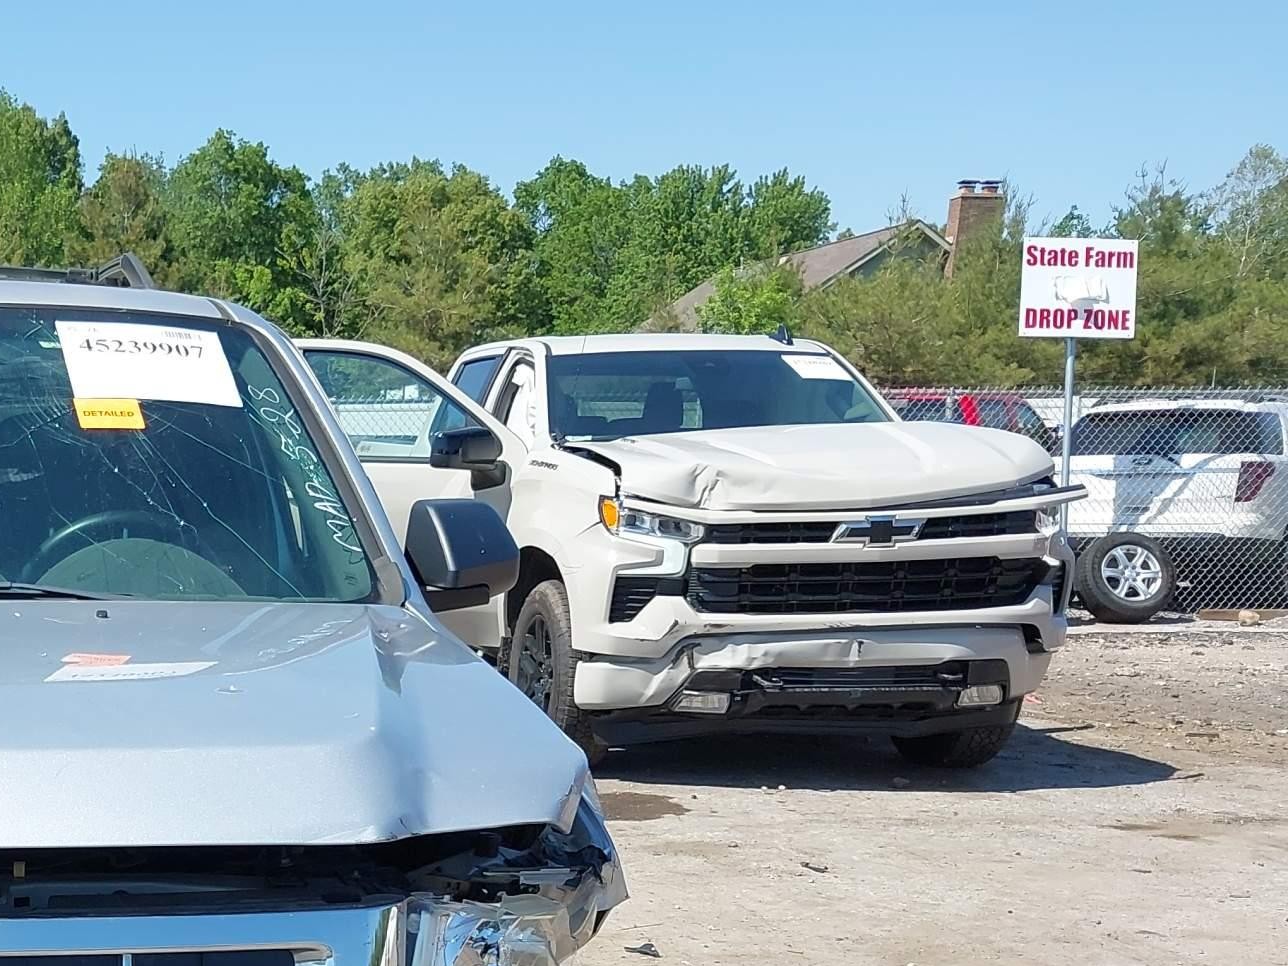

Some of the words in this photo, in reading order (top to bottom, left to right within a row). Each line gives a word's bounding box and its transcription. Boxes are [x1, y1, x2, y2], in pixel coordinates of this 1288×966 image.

[1026, 245, 1079, 267] State
[1085, 247, 1135, 268] Farm
[1025, 307, 1078, 329] DROP
[1083, 309, 1131, 330] ZONE
[78, 338, 203, 359] 45239907
[83, 409, 135, 418] DETAILED
